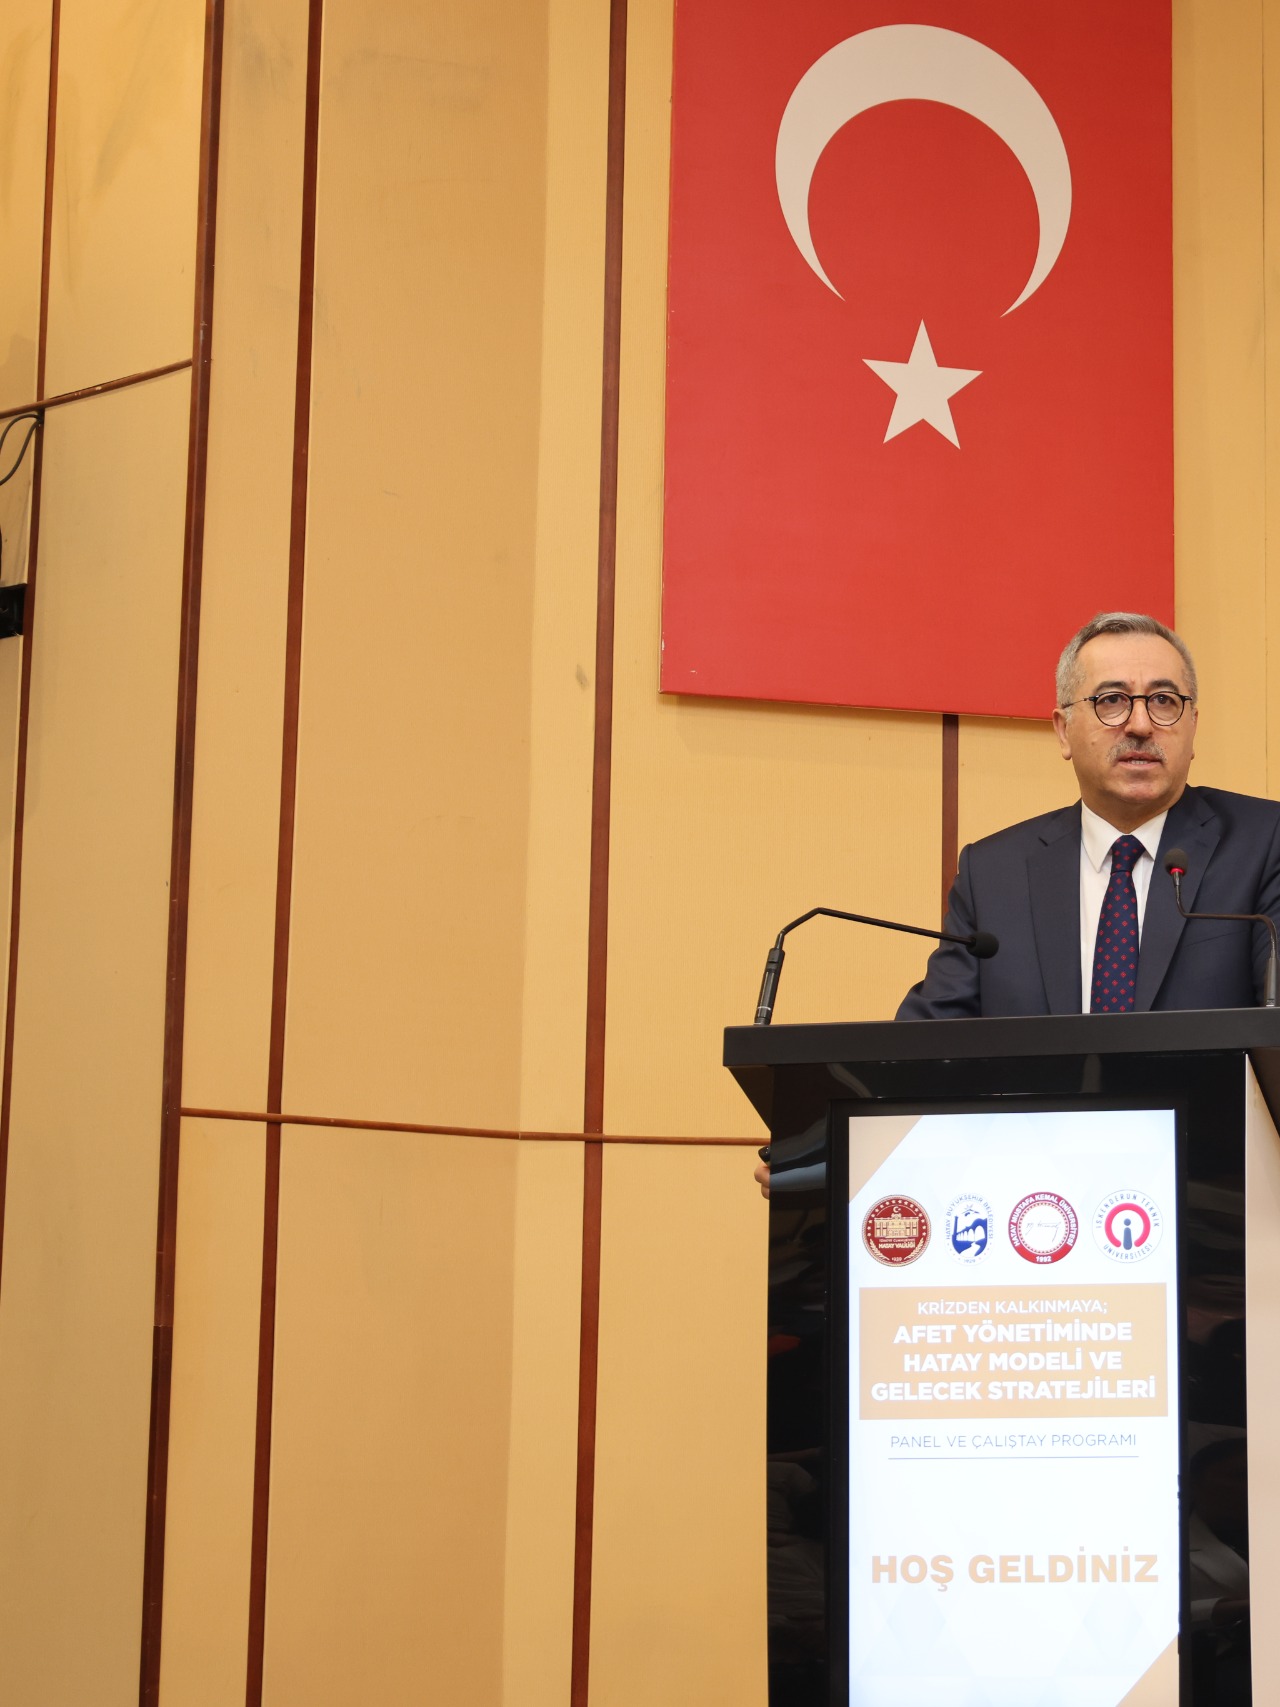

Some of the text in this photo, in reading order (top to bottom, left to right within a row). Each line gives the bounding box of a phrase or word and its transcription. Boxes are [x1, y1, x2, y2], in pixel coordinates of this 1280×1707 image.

[1011, 1196, 1036, 1223] MUSTAFA
[1034, 1193, 1059, 1204] KEMAL
[1010, 1223, 1021, 1247] HATAY
[1036, 1255, 1052, 1263] 1992
[917, 1298, 1108, 1315] KRİZDEN KALKINMAYA;
[892, 1318, 1133, 1344] AFET YÖNETİMİNDE
[903, 1347, 1122, 1373] HATAY MODELİ VE
[871, 1375, 1156, 1401] GELECEK STRATEJİLERİ
[890, 1432, 1137, 1450] PANEL VE ÇALIŞTAY PROGRAMI
[871, 1545, 1159, 1592] HOŞ GELDİNİZ
